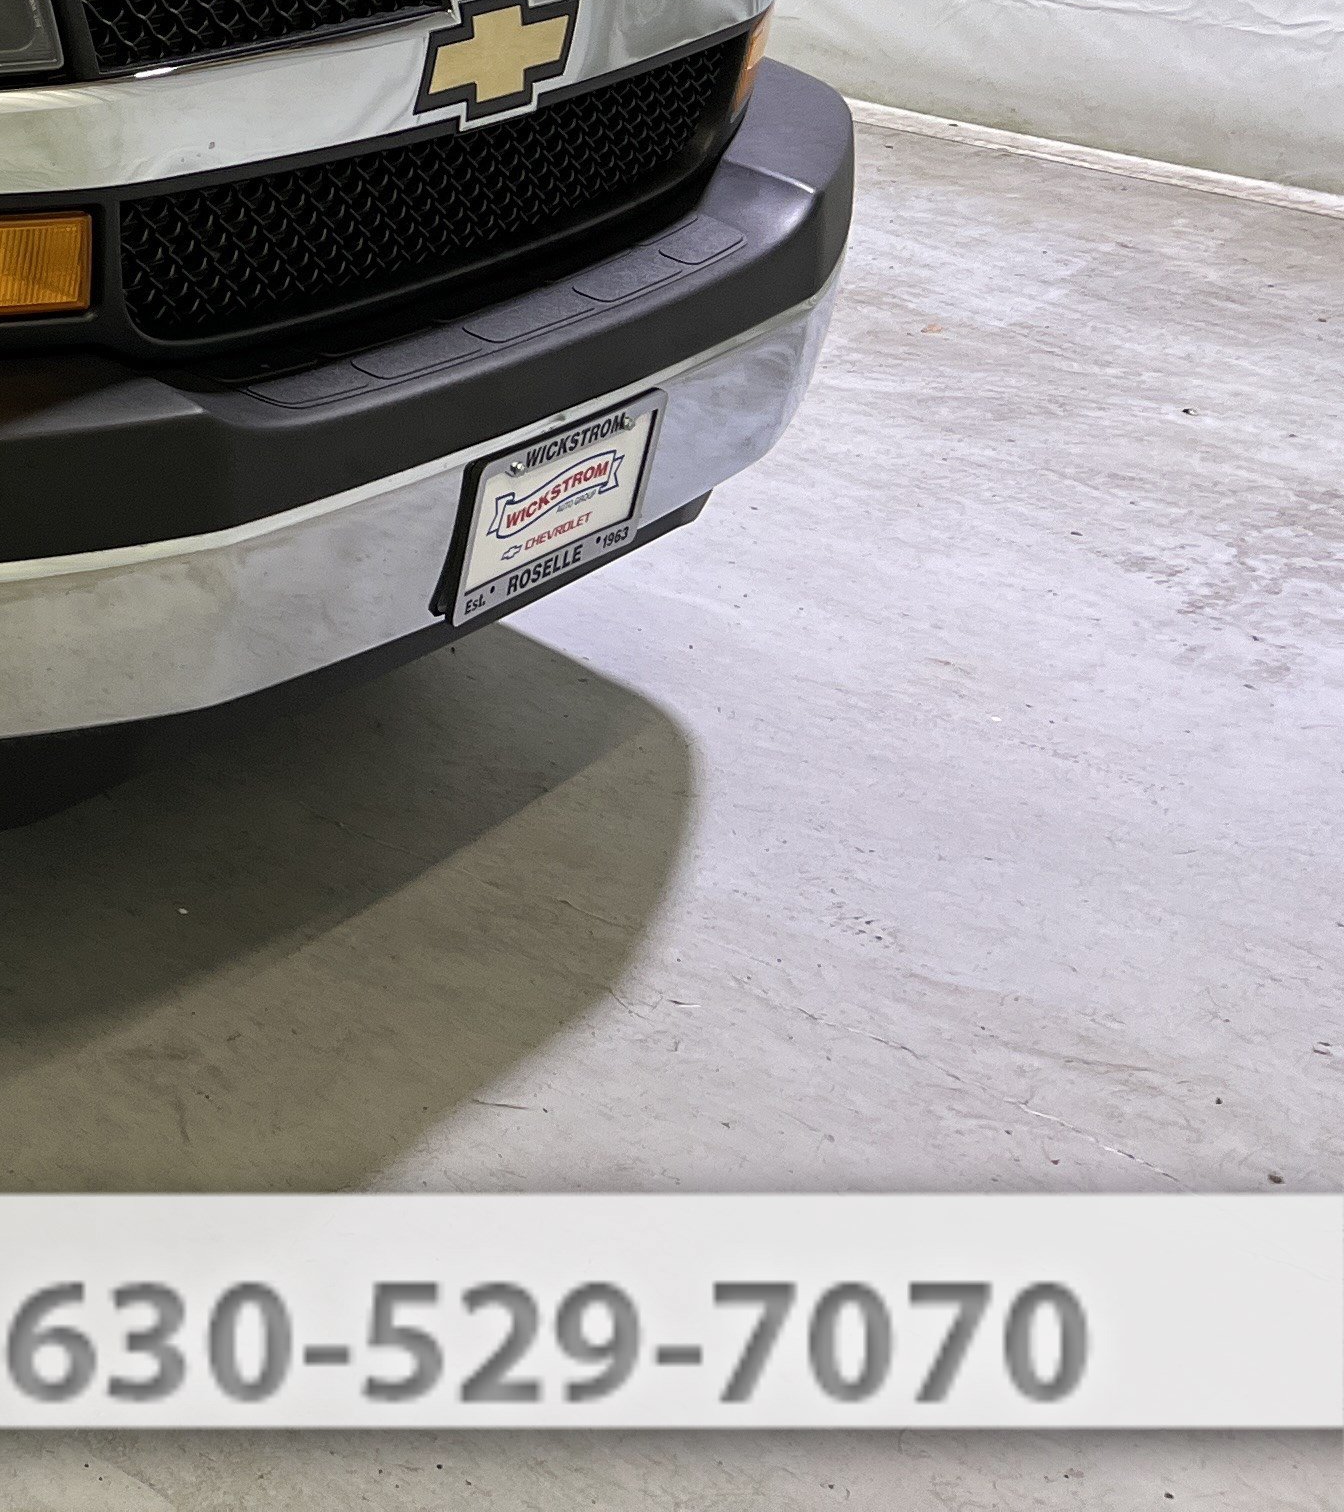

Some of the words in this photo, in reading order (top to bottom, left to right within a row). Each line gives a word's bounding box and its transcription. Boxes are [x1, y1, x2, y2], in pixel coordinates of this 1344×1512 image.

[525, 413, 625, 469] WICKSTROM
[505, 460, 609, 530] WICKSTROM
[524, 511, 593, 550] CHEVROLET
[464, 596, 486, 615] Est.
[507, 544, 584, 595] ROSELLE
[602, 526, 629, 549] 1963
